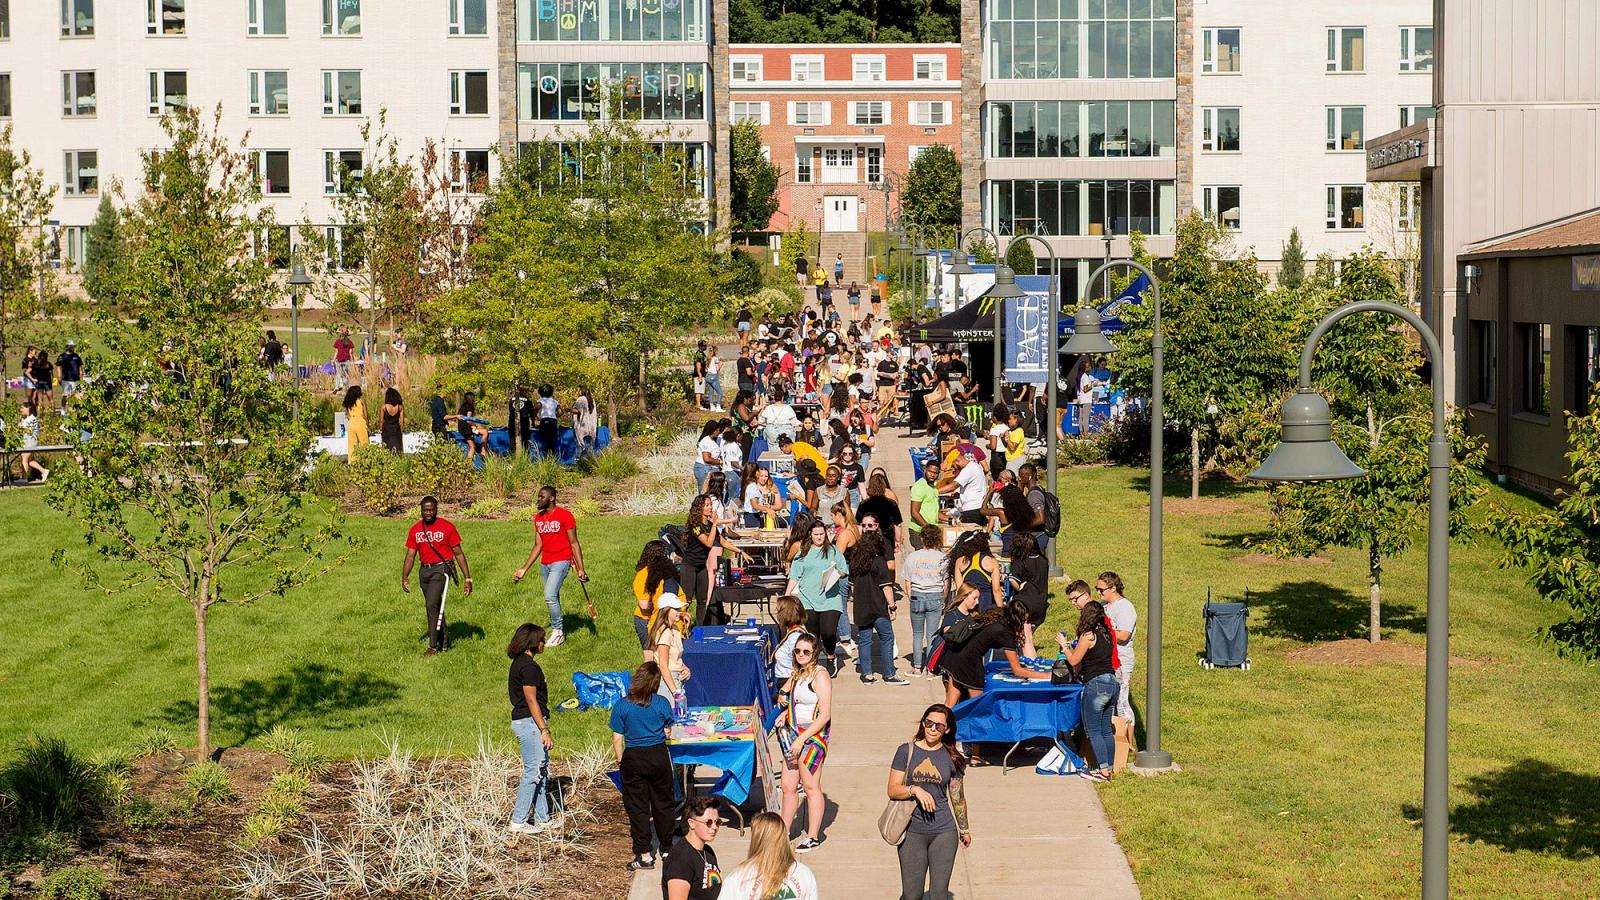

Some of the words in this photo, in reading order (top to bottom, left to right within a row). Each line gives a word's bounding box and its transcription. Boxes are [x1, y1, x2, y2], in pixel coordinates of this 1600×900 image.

[953, 330, 995, 338] MONSTER
[1016, 294, 1040, 369] PACE
[1041, 294, 1049, 368] UNIVERSITY
